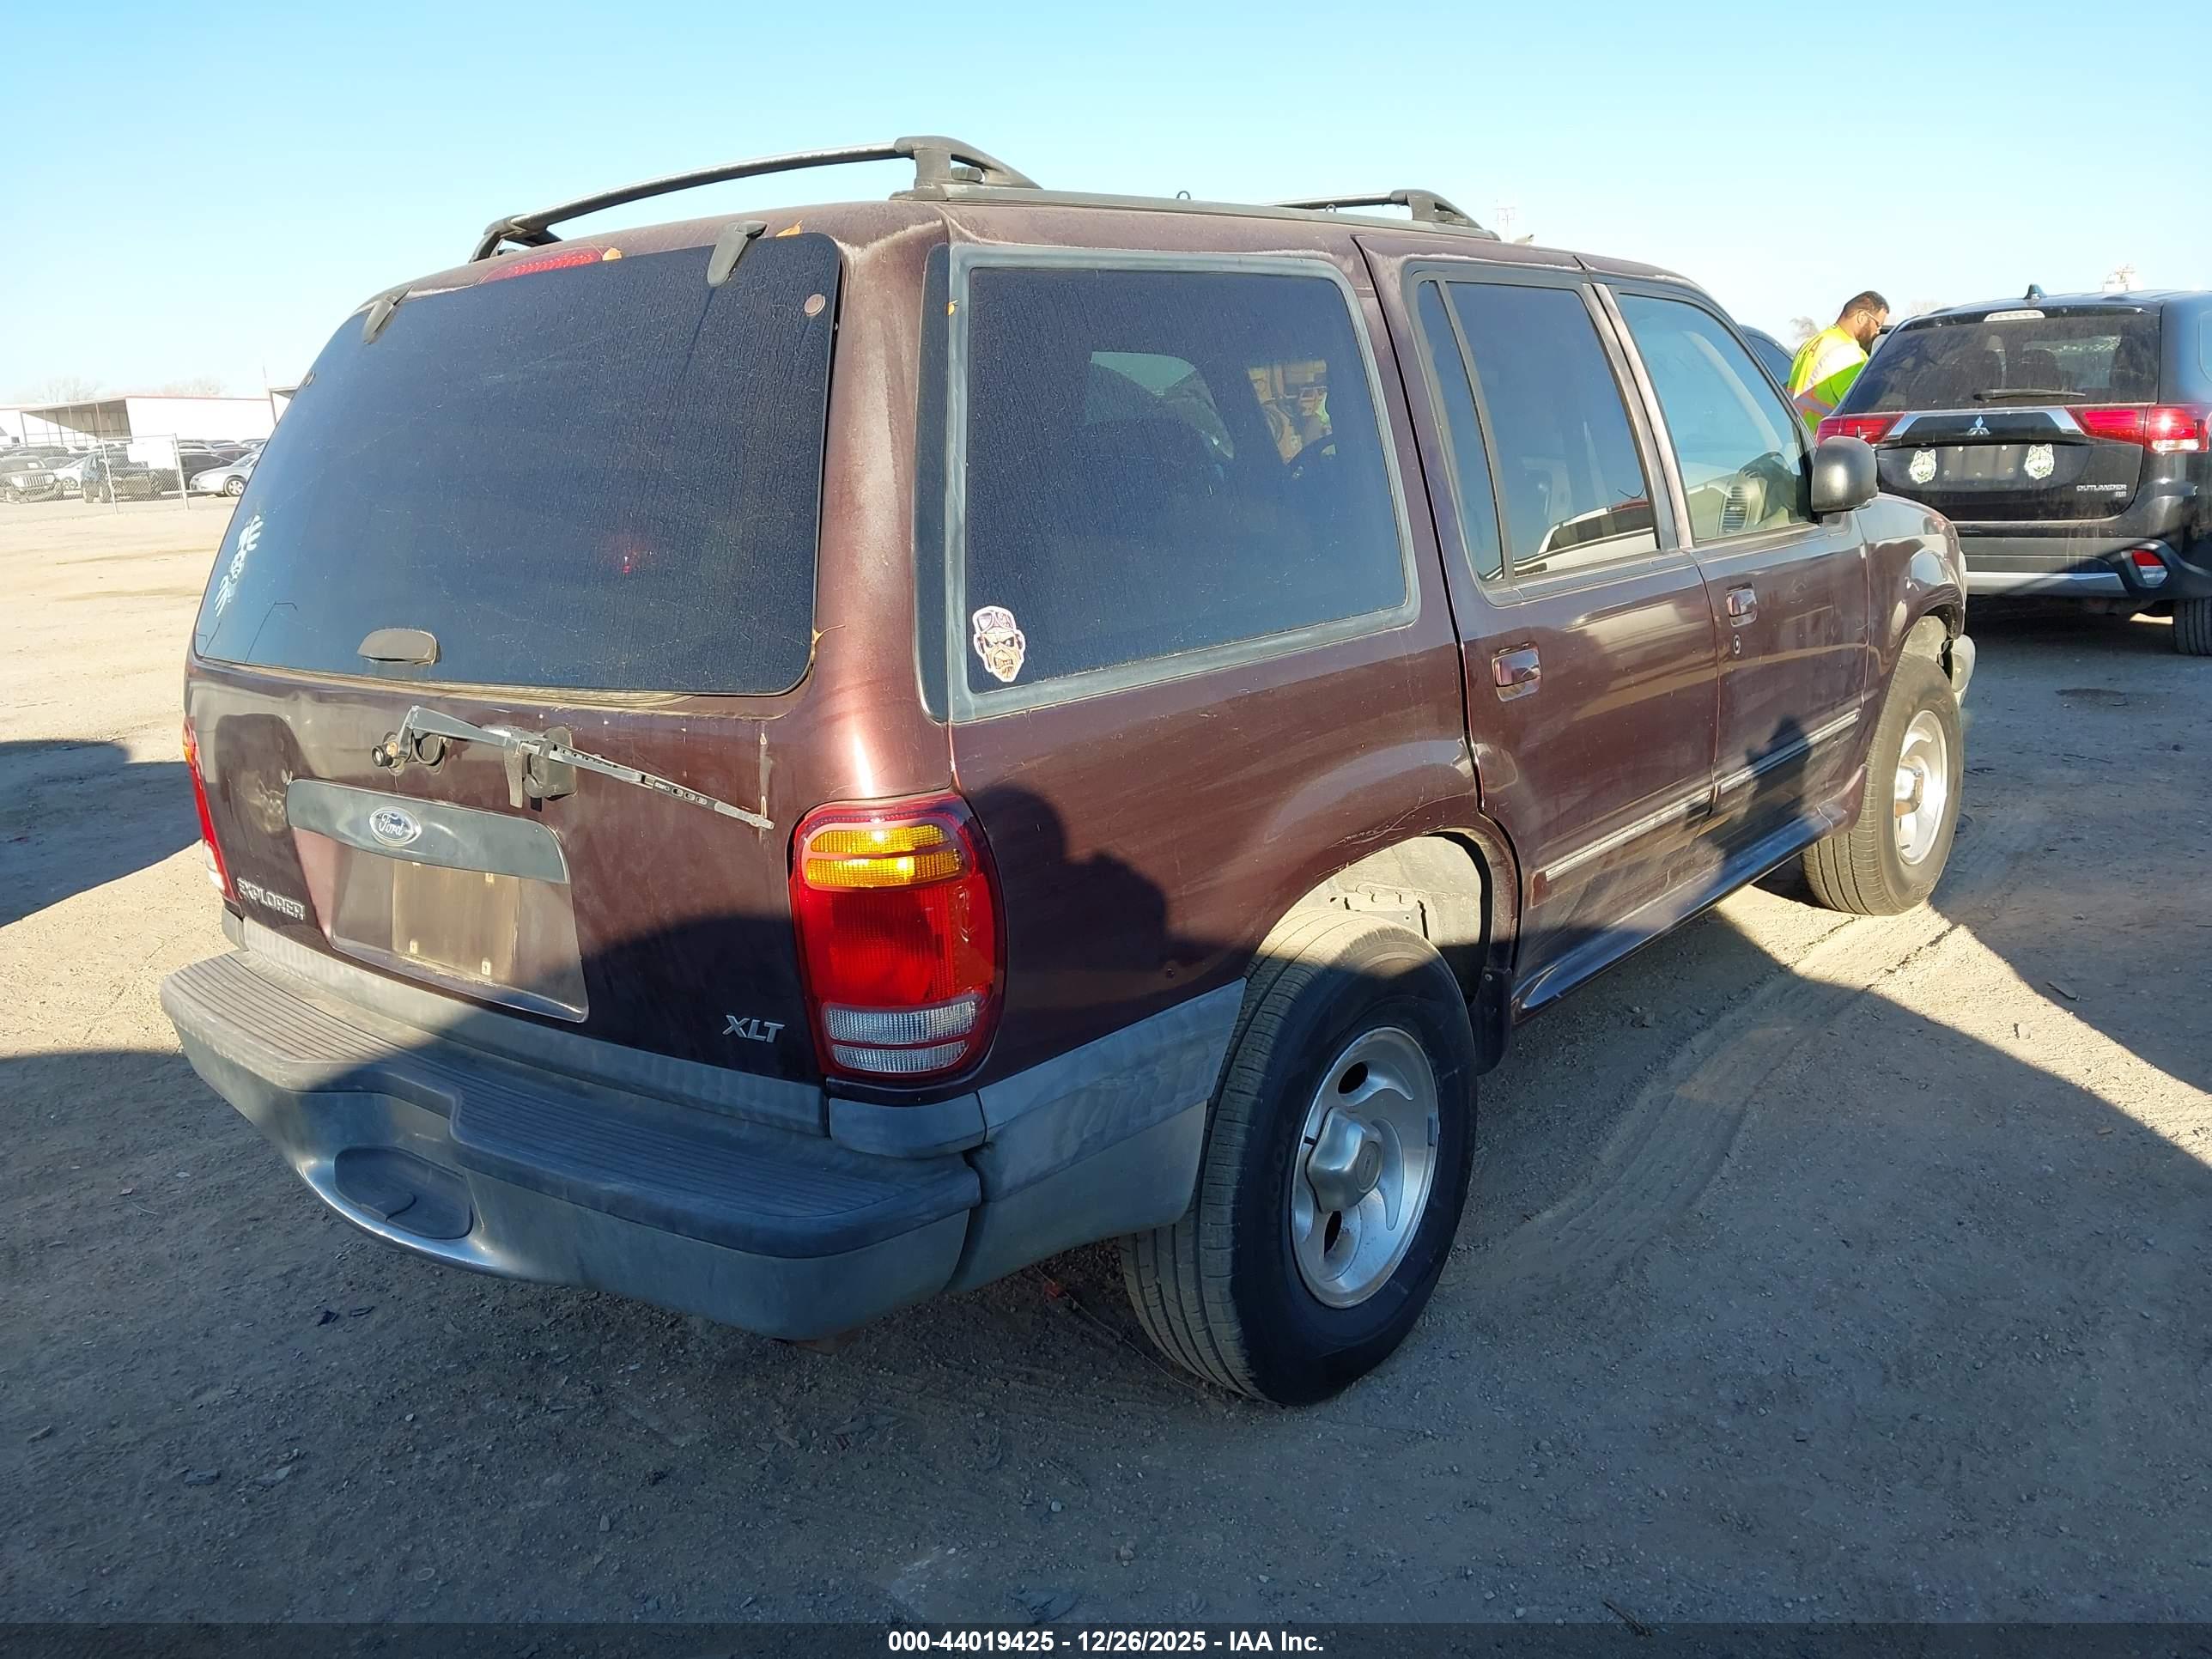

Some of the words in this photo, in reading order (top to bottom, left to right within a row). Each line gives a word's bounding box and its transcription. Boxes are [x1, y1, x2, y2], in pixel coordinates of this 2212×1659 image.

[2075, 483, 2128, 492] OUTLANDER
[236, 876, 305, 921] EXPLORER
[722, 1014, 786, 1043] XLT
